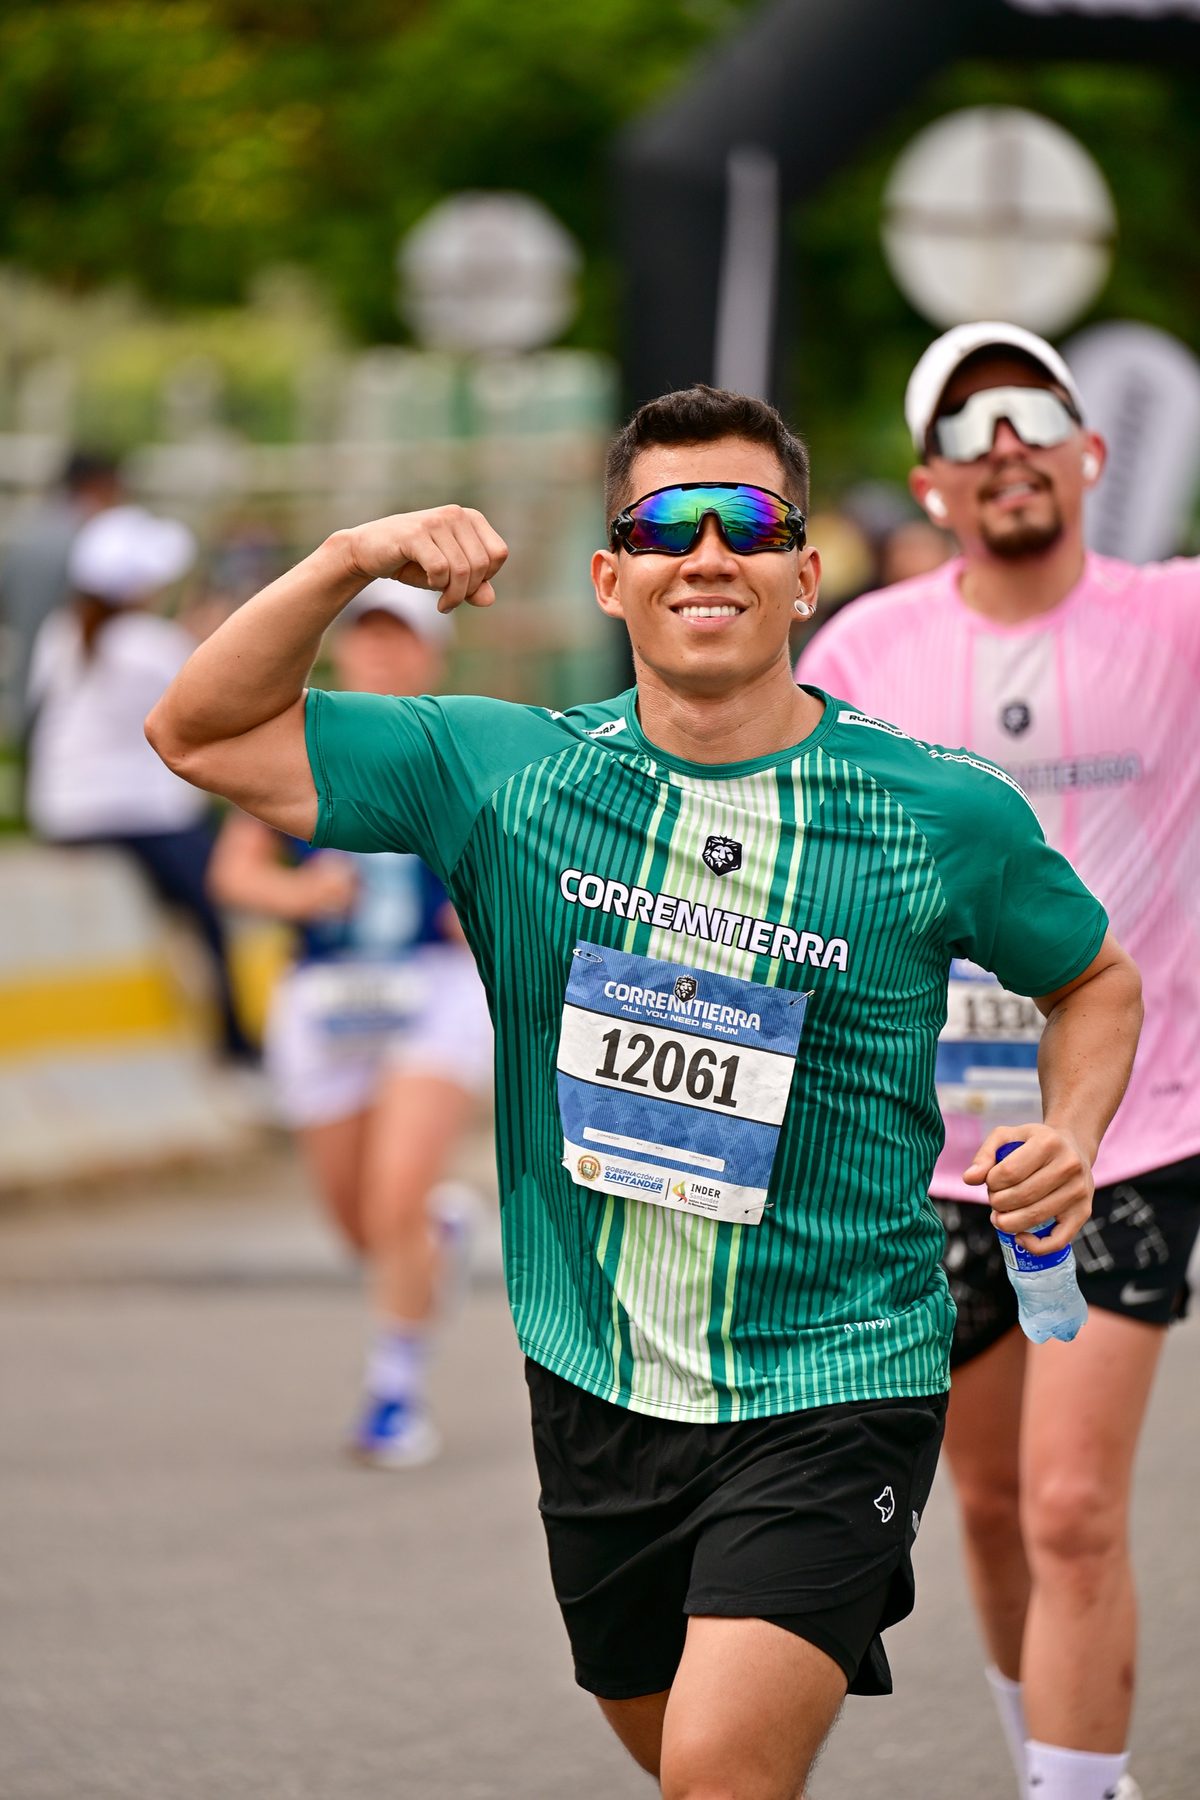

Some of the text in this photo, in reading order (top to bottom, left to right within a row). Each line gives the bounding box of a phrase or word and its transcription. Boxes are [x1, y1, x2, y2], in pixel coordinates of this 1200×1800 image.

[560, 868, 850, 972] CORREMITIERRA
[621, 1004, 738, 1035] ALL YOU NEED IS RUN
[595, 1028, 740, 1108] 12061
[604, 1165, 654, 1181] GOBERNACIÓN
[604, 1171, 664, 1191] SANTANDER
[690, 1183, 721, 1199] INDER
